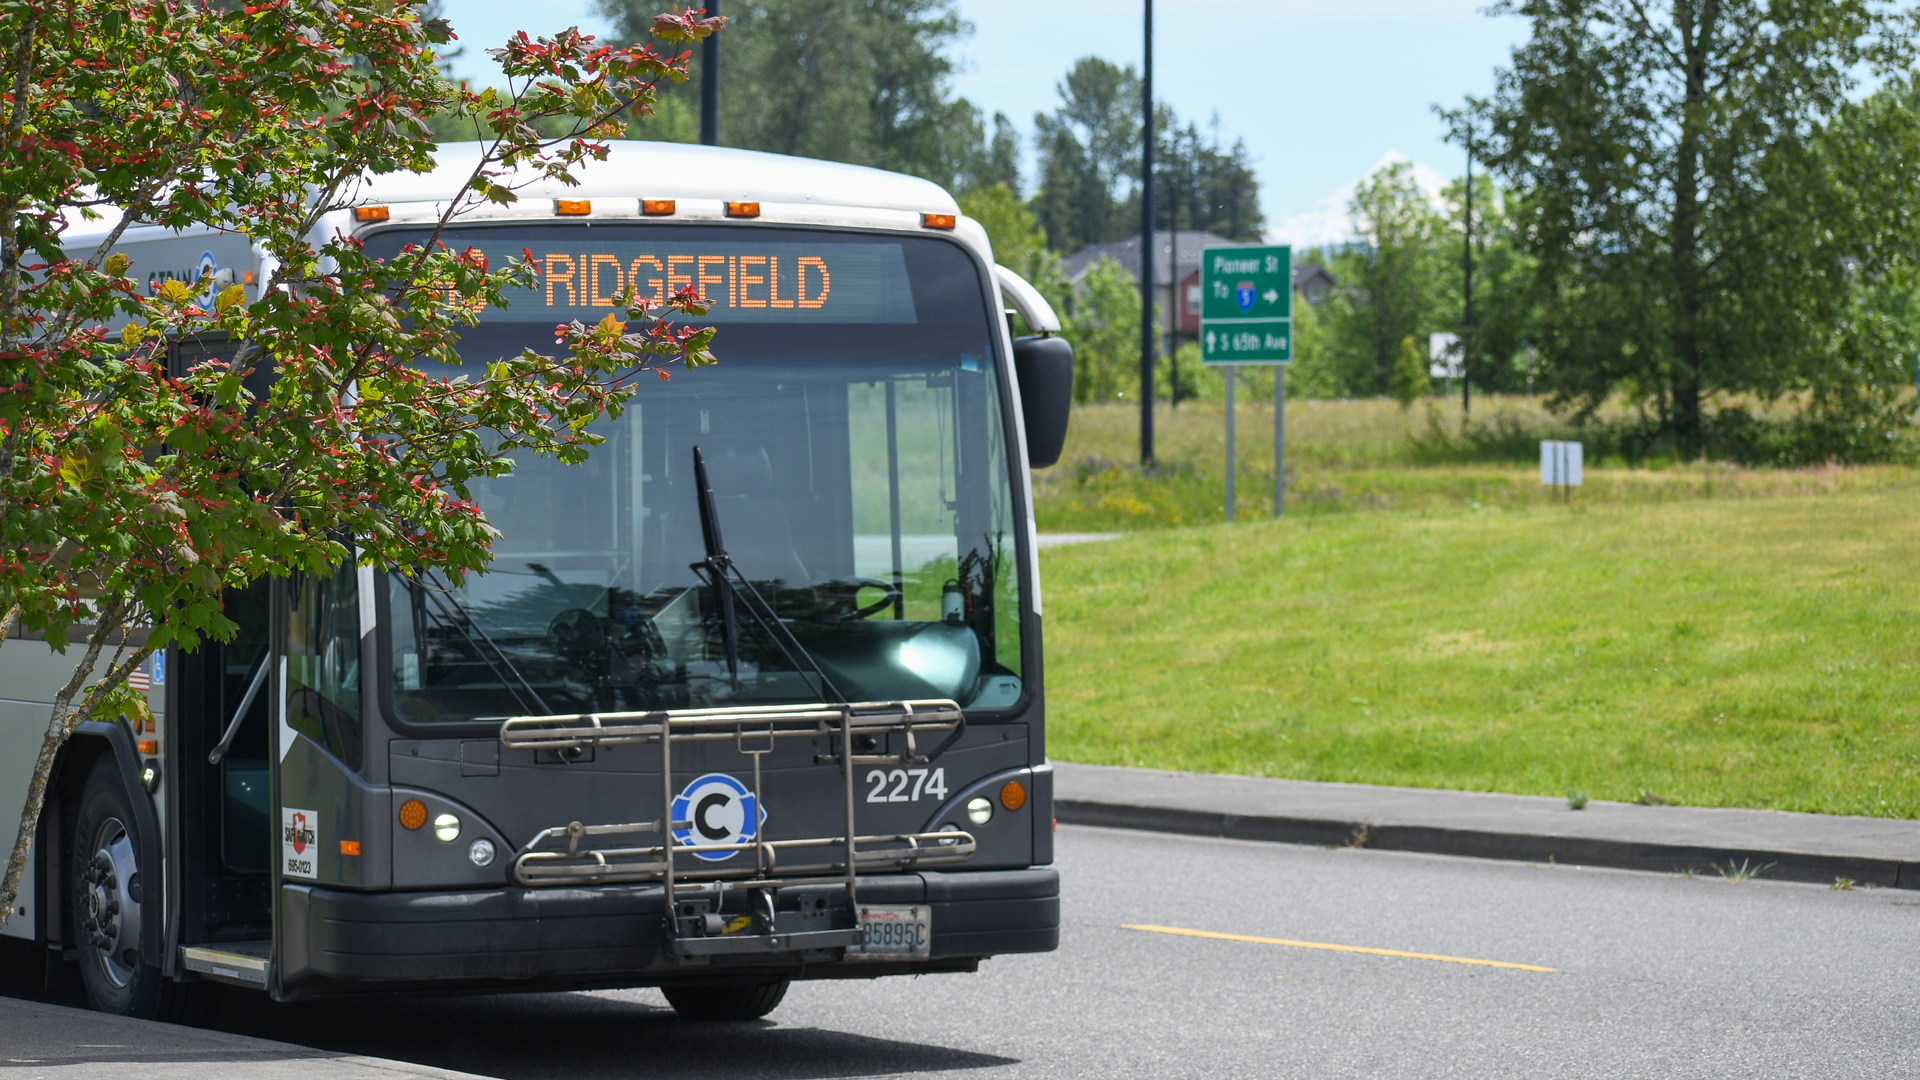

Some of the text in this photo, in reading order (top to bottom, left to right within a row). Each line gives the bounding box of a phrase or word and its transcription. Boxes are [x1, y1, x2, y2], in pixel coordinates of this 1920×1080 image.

[1213, 254, 1279, 274] Pioneer St
[546, 253, 830, 308] RIDGEFIELD
[1213, 280, 1251, 307] To 5
[1220, 332, 1288, 351] S 65th Ave
[866, 767, 949, 803] 2274
[694, 793, 731, 840] C
[288, 858, 311, 874] 695-0123
[863, 922, 925, 945] 85895C
